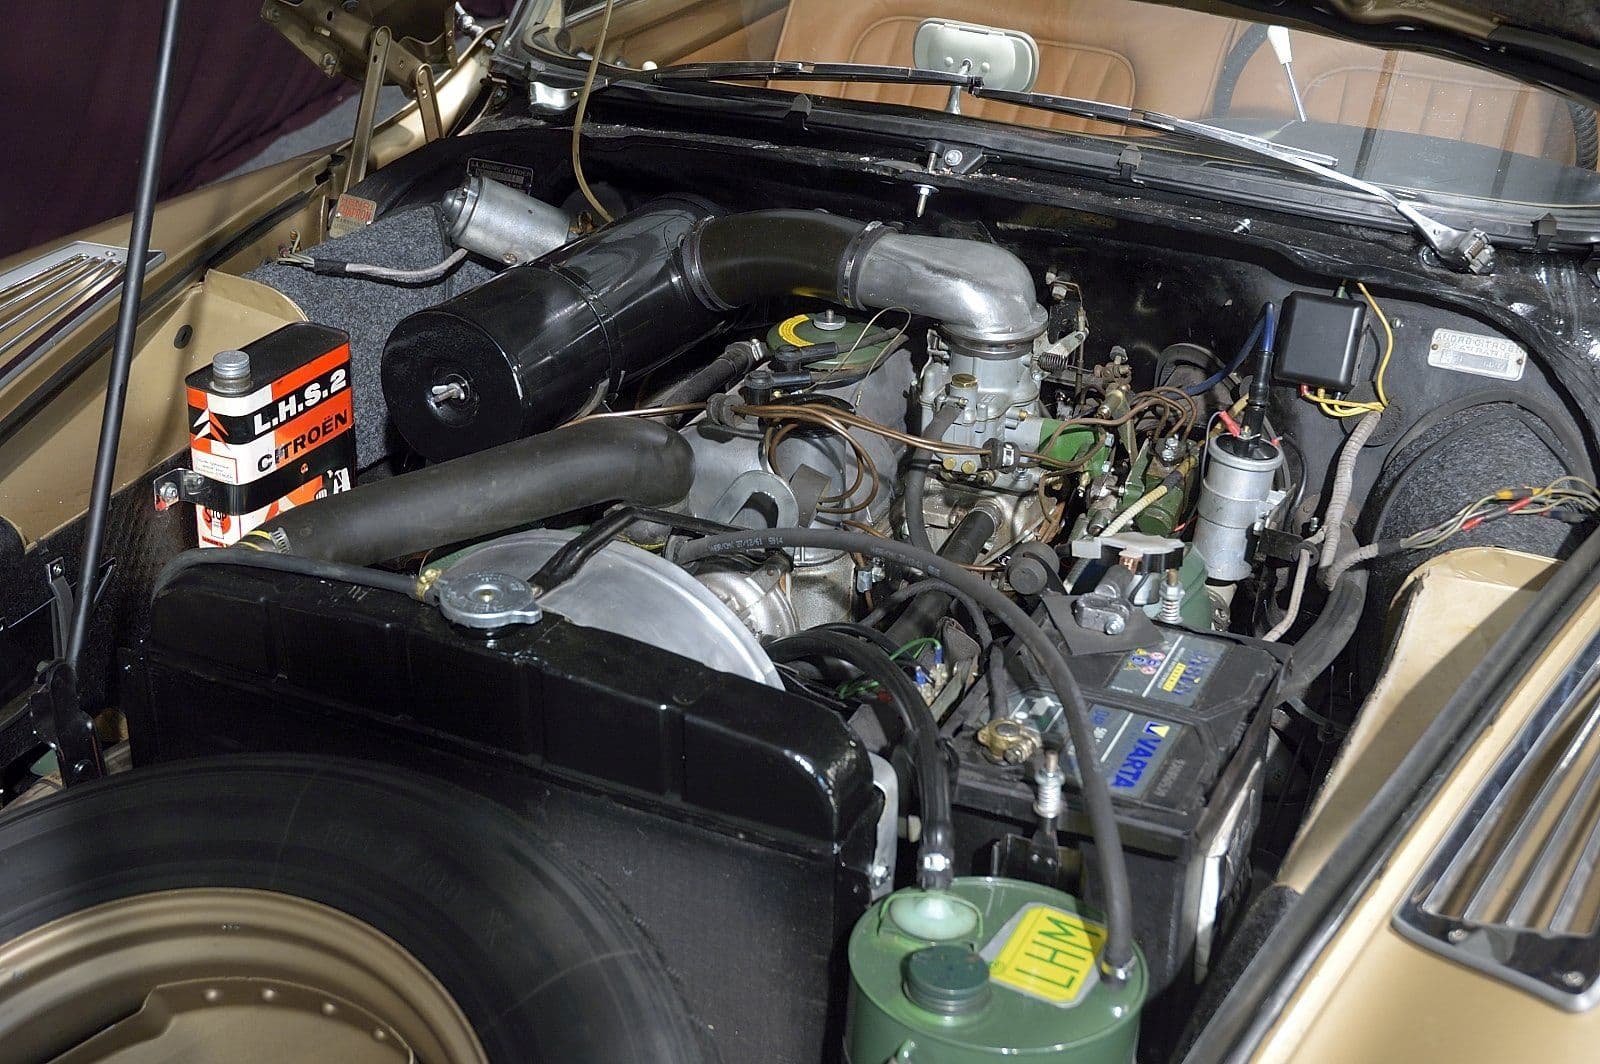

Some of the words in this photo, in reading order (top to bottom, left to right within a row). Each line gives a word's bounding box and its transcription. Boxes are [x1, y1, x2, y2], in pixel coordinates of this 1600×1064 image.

[253, 368, 347, 436] L.H.S.2
[257, 409, 348, 473] CITROËN
[1111, 738, 1162, 788] VARTA
[1014, 915, 1102, 989] LHM
